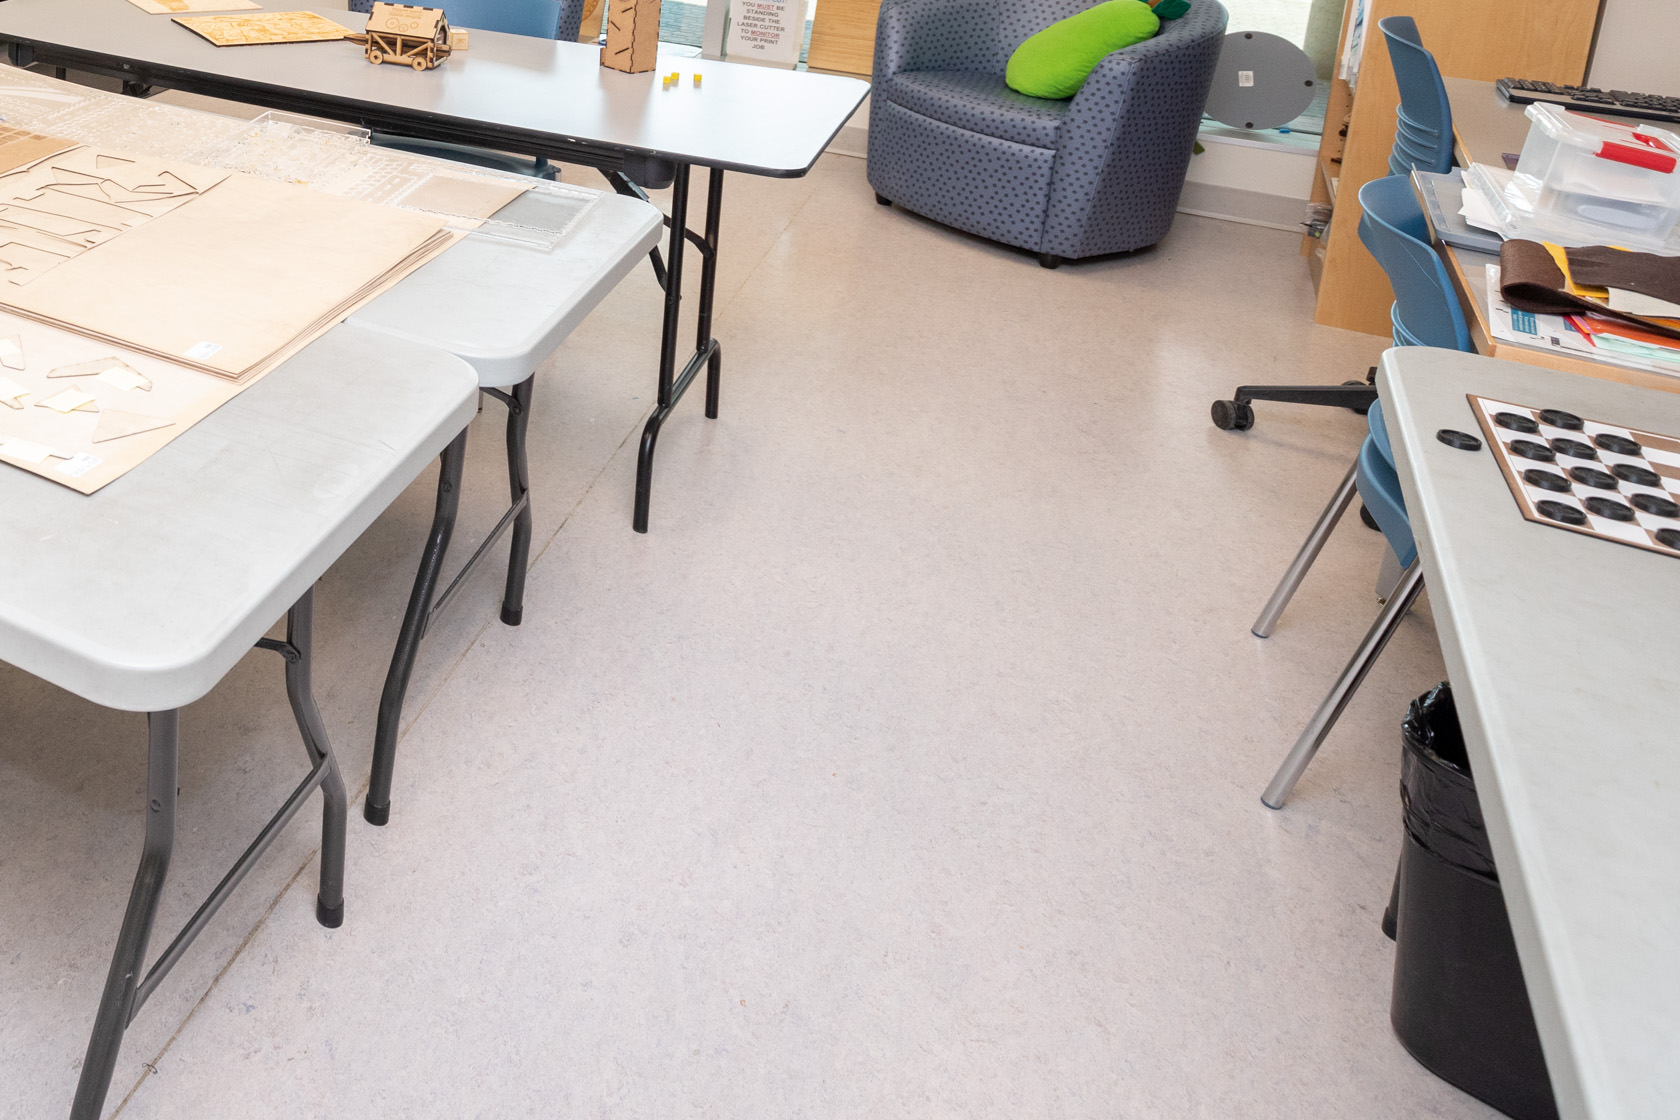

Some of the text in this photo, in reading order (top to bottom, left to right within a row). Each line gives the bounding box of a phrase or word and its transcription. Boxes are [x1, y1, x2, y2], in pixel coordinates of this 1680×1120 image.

[746, 9, 779, 17] STANDING
[760, 24, 785, 32] CUTTER
[751, 30, 780, 38] MONITOR
